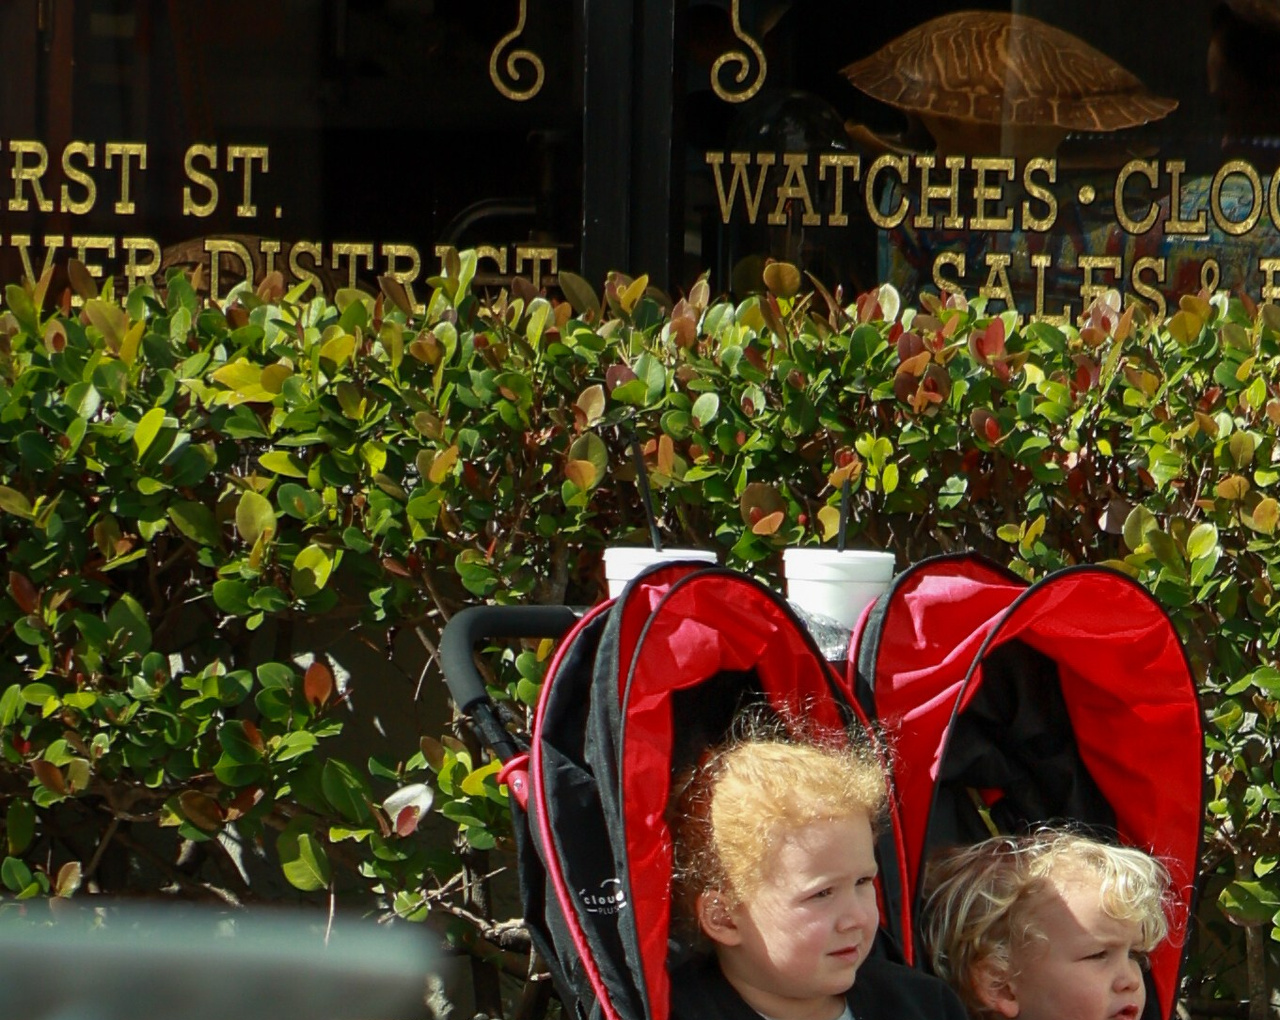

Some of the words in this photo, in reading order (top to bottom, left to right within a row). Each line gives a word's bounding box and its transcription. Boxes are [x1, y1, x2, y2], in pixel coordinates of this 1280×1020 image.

[0, 140, 148, 215] RST
[182, 144, 283, 218] ST.
[705, 151, 1059, 232] WATCHES
[0, 234, 165, 308] VER
[931, 252, 1168, 328] SALES
